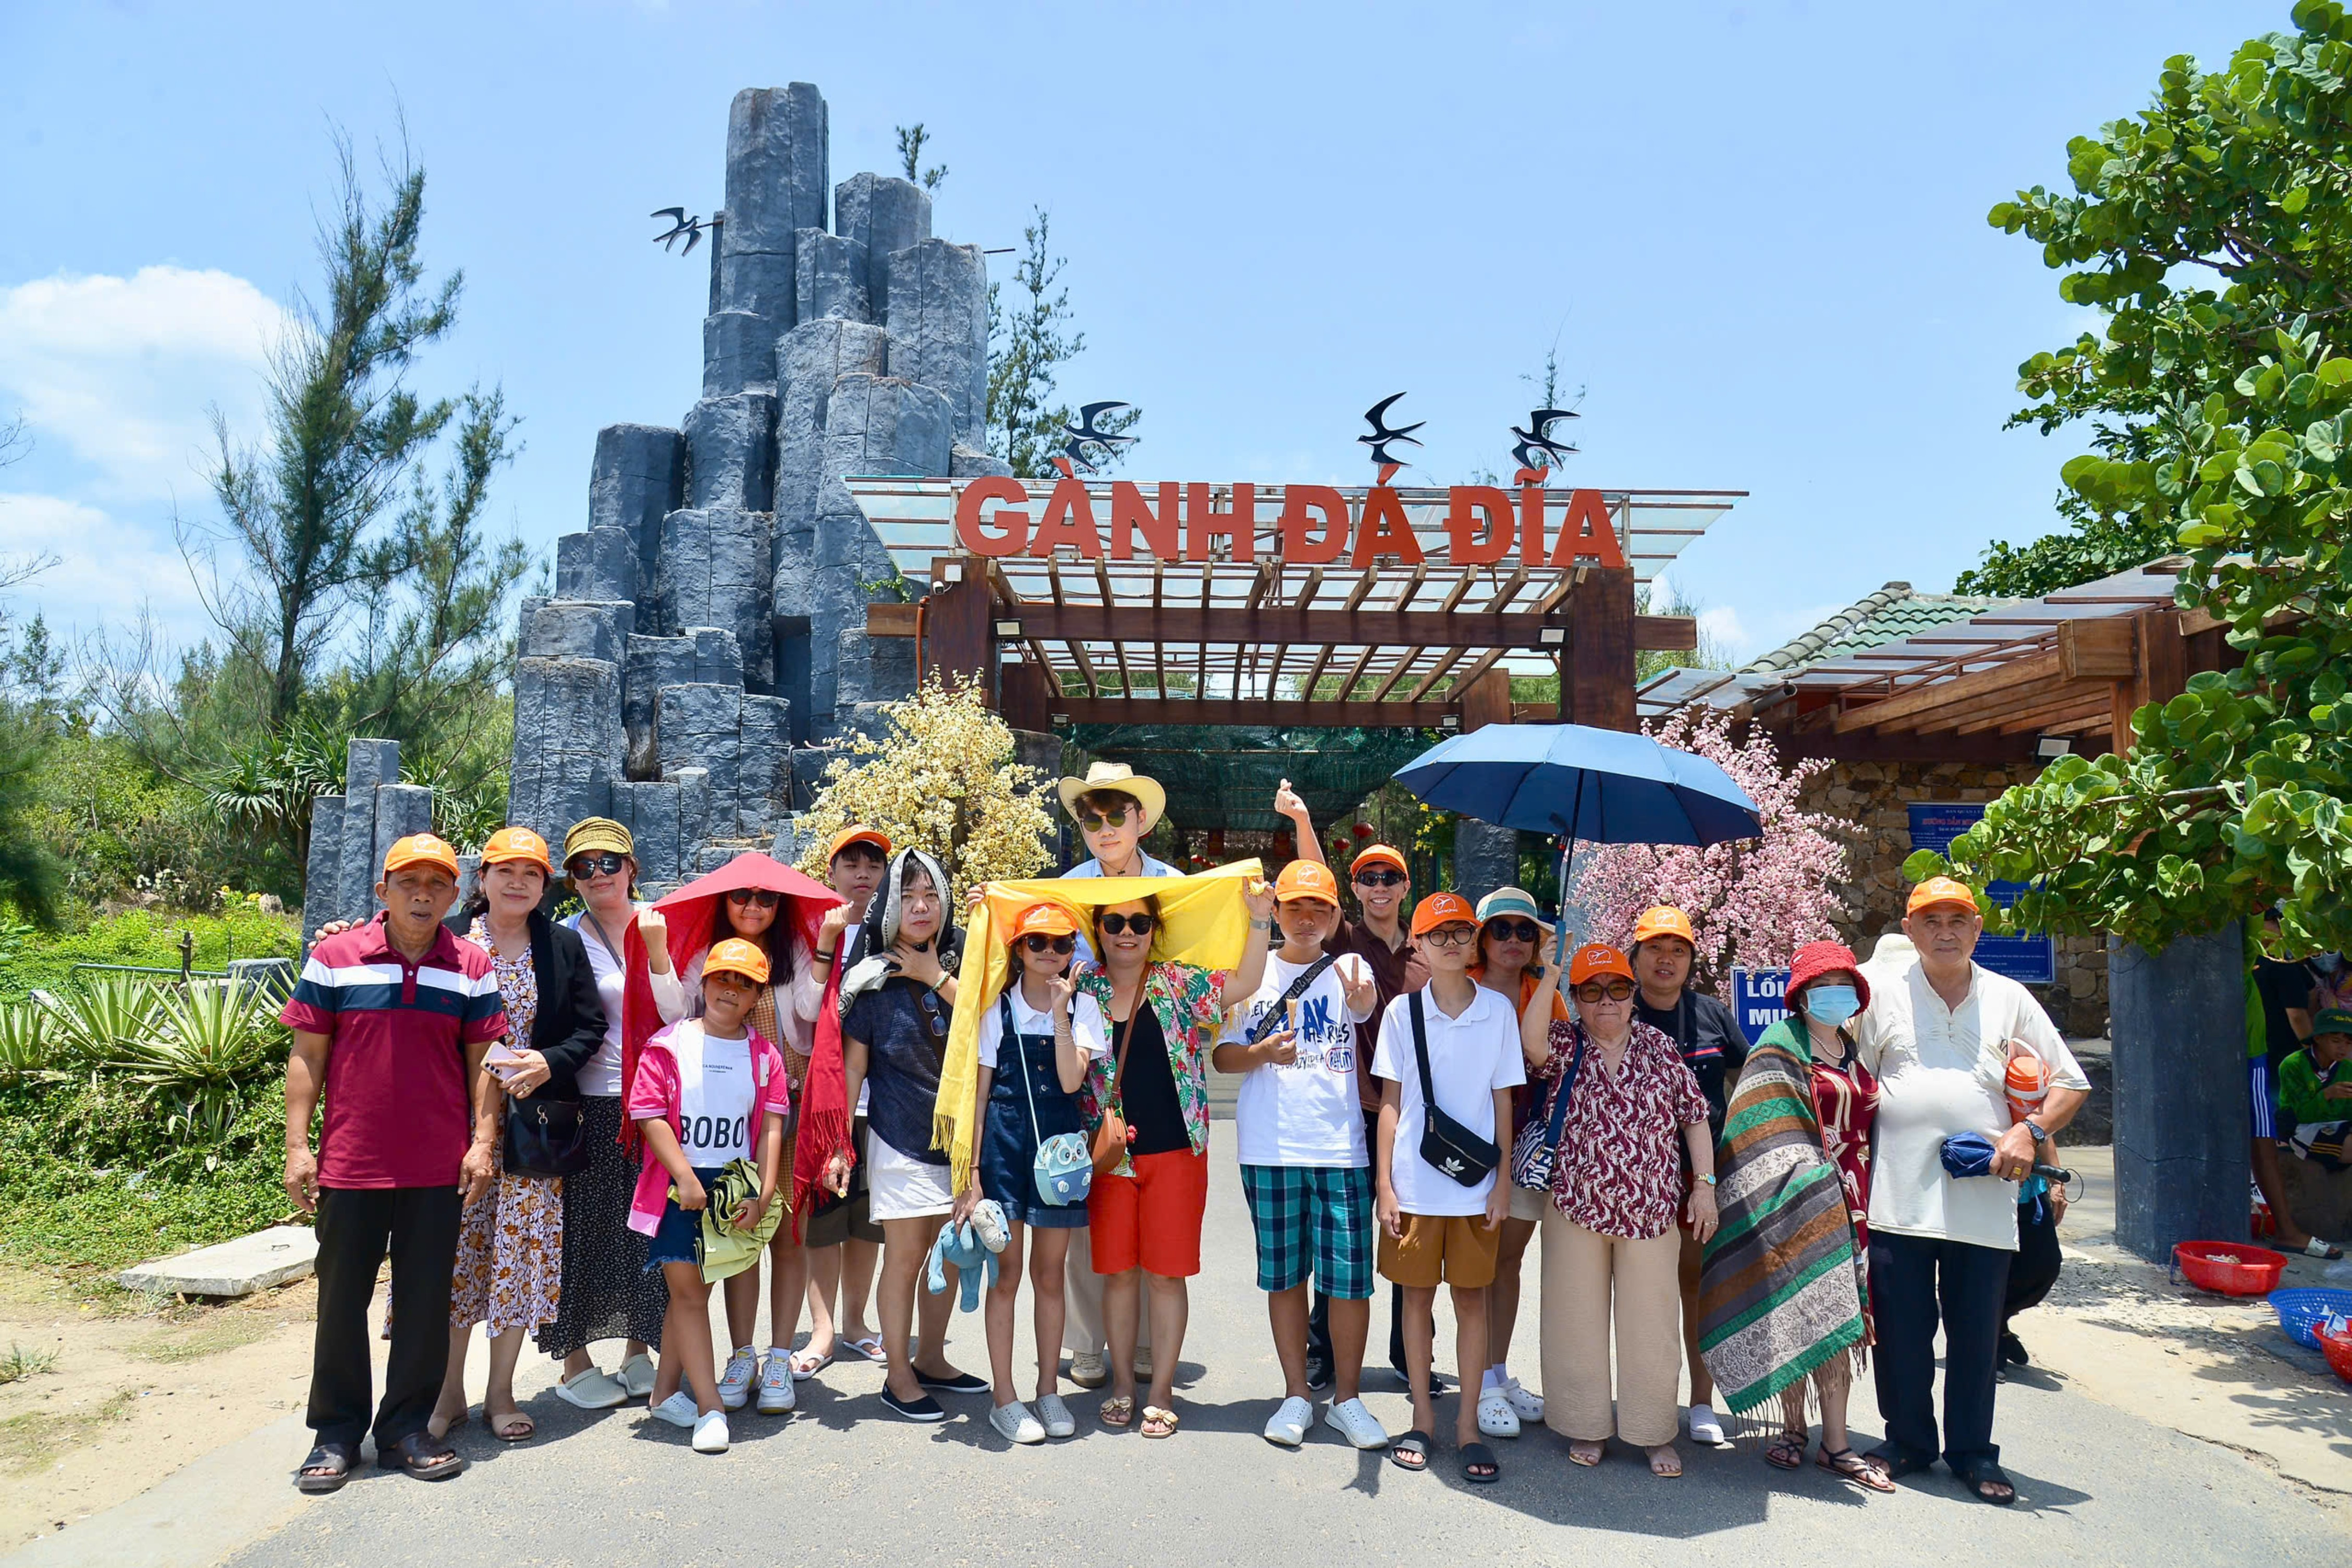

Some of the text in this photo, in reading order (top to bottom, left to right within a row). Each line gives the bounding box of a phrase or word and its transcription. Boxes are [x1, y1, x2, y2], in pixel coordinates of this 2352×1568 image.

[956, 458, 1626, 569] GÀNH ĐÁ ĐĨA
[1747, 975, 1785, 998] LỐI
[1749, 1009, 1796, 1025] MU
[1307, 1052, 1325, 1063] IDEA
[680, 1115, 745, 1148] BOBO
[1438, 1164, 1457, 1177] adidas
